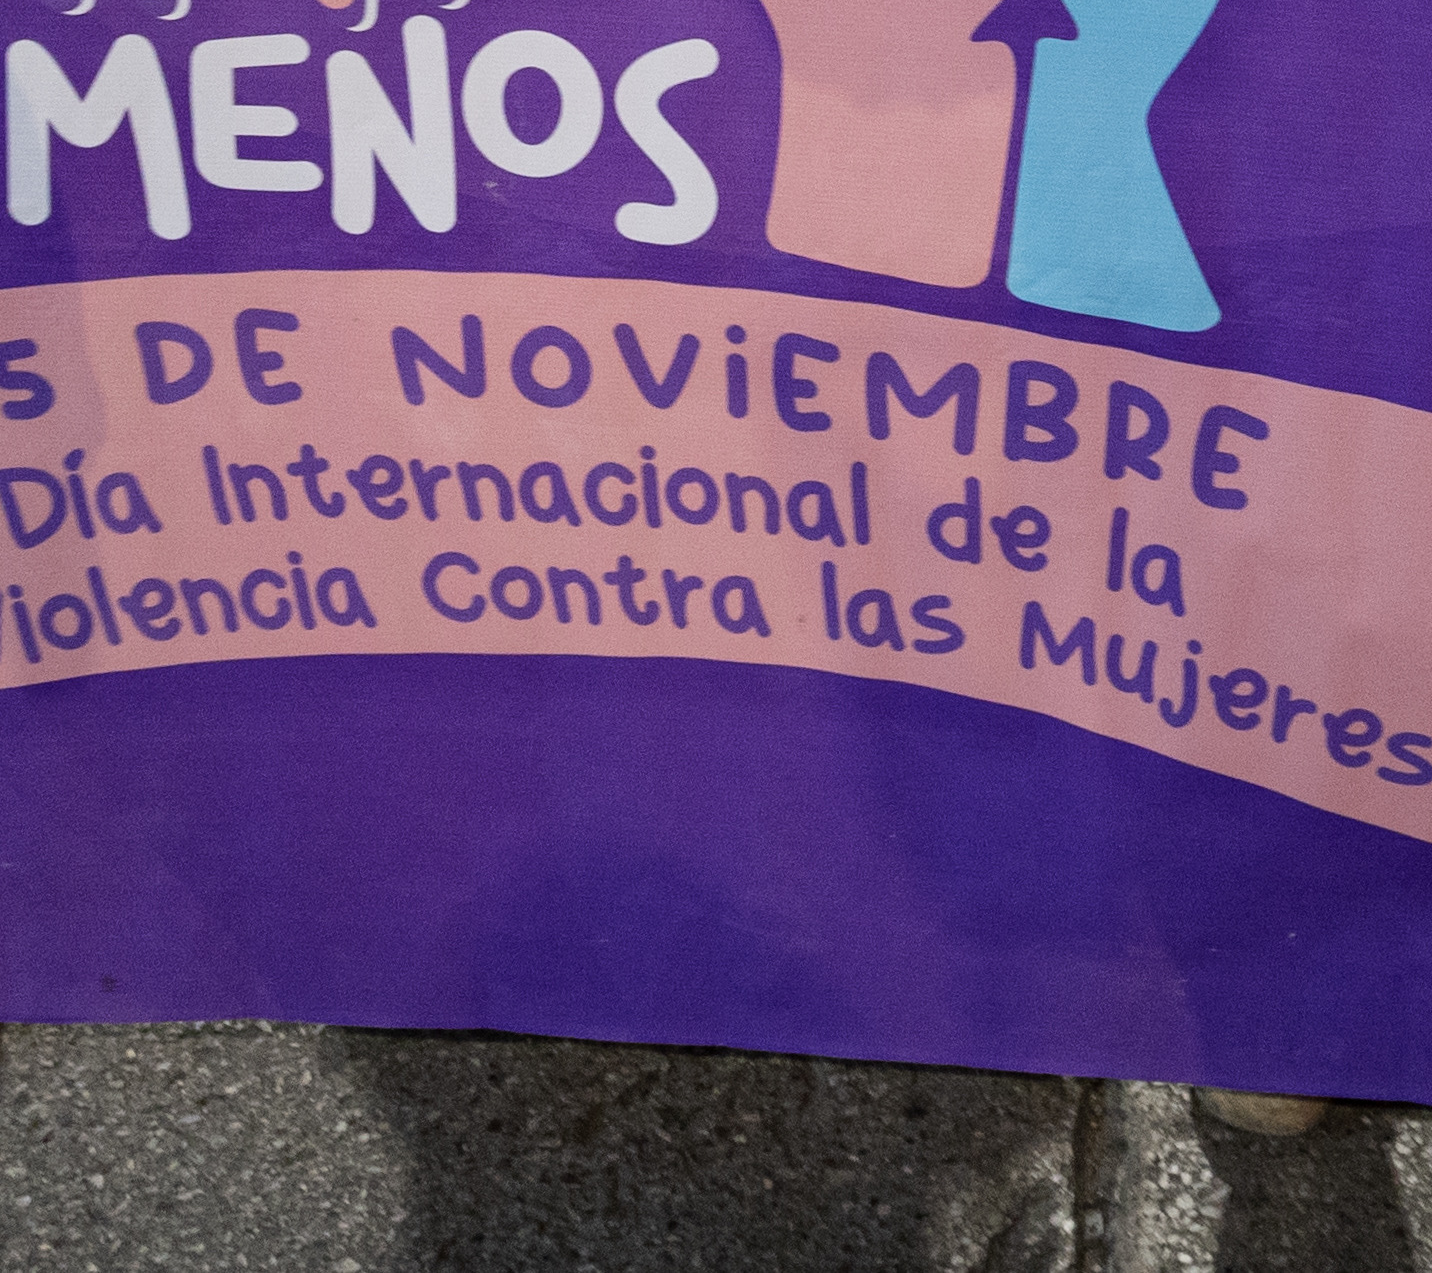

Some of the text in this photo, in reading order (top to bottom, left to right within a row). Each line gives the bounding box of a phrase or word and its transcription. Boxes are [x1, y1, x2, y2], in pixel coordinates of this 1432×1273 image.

[5, 15, 720, 246] MENOS
[135, 308, 303, 406] DE
[202, 444, 871, 547] Internacional
[926, 476, 1052, 572] de
[1106, 506, 1185, 617] la
[422, 551, 771, 637] Contra
[822, 560, 966, 655] las
